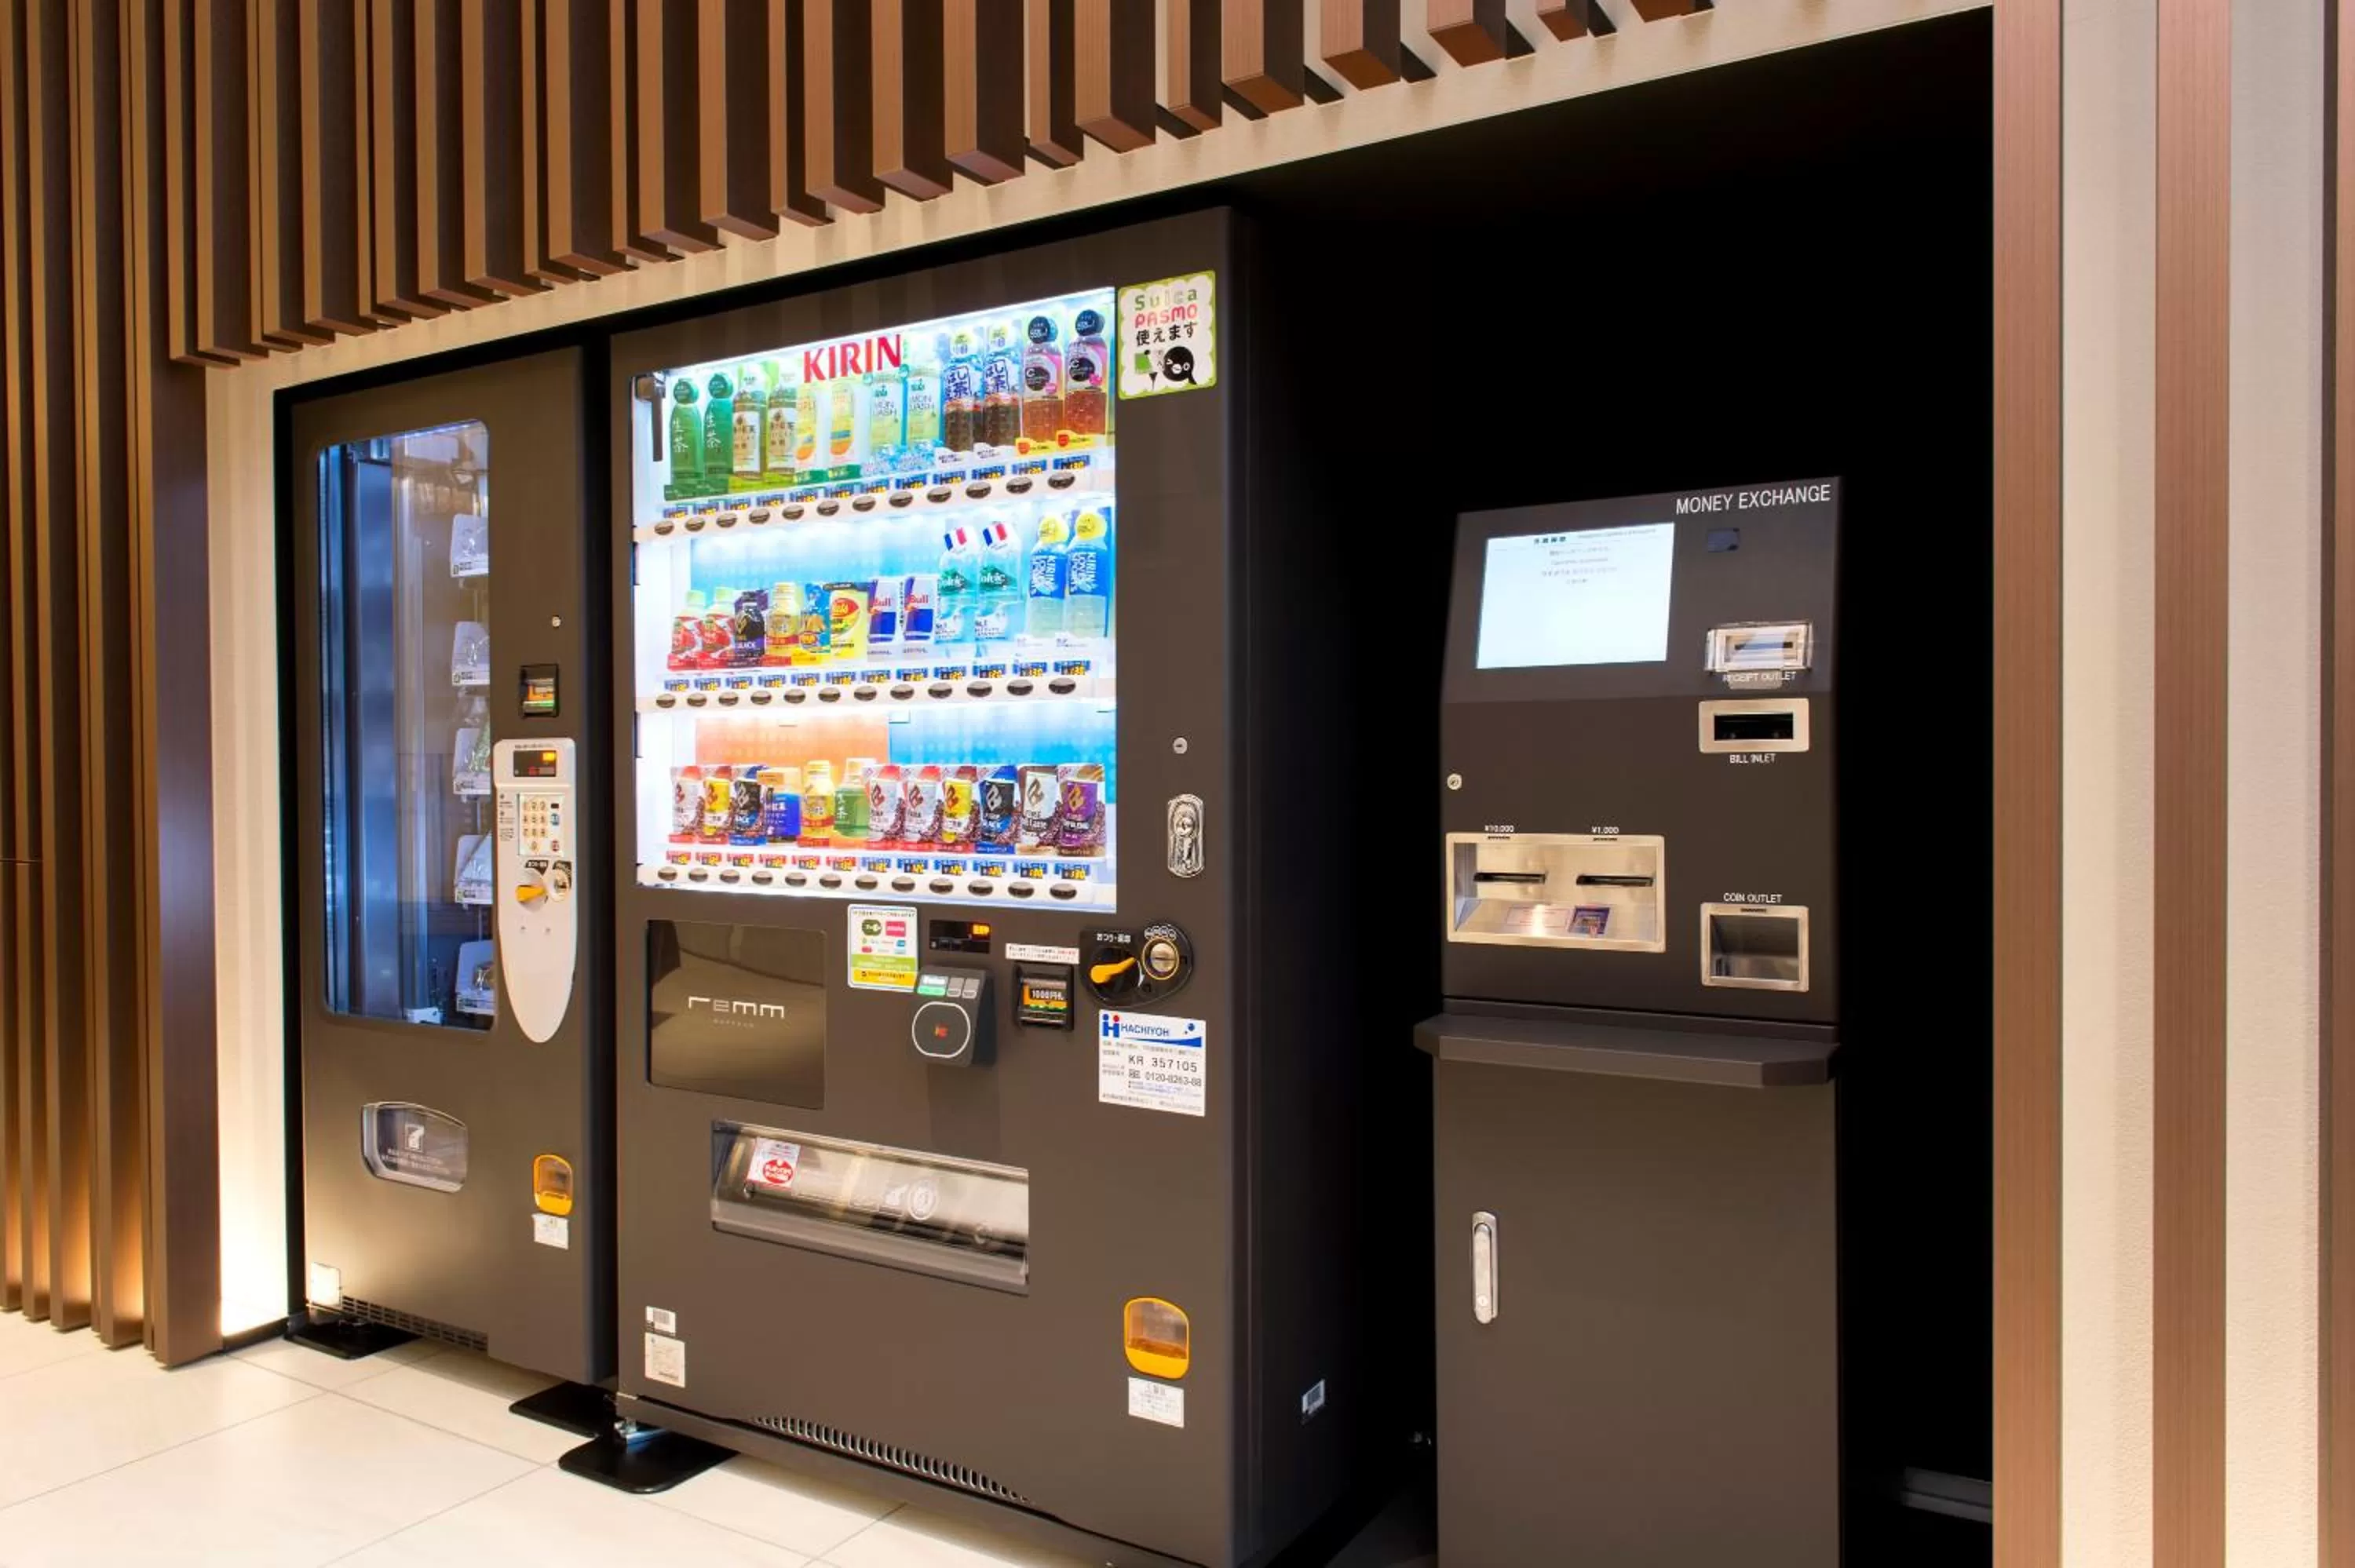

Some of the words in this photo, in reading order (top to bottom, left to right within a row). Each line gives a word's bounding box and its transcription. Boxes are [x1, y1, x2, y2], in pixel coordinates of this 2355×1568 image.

[1134, 288, 1198, 311] Suica
[1134, 303, 1198, 329] PASMO
[1136, 321, 1199, 347] 使えます
[803, 334, 903, 383] KIRIN
[1676, 494, 1732, 515] MONEY
[1738, 484, 1831, 509] EXCHANGE
[1722, 673, 1758, 682] RECEIPT
[1761, 671, 1796, 681] OUTLET
[1729, 754, 1749, 764] BILL
[1751, 753, 1776, 764] INLET
[1723, 892, 1745, 903] COIN
[1747, 893, 1782, 903] OUTLET
[688, 996, 785, 1019] remm
[1120, 1023, 1170, 1036] HACHIYOH
[1129, 1055, 1144, 1065] KR
[1152, 1057, 1198, 1073] 357105
